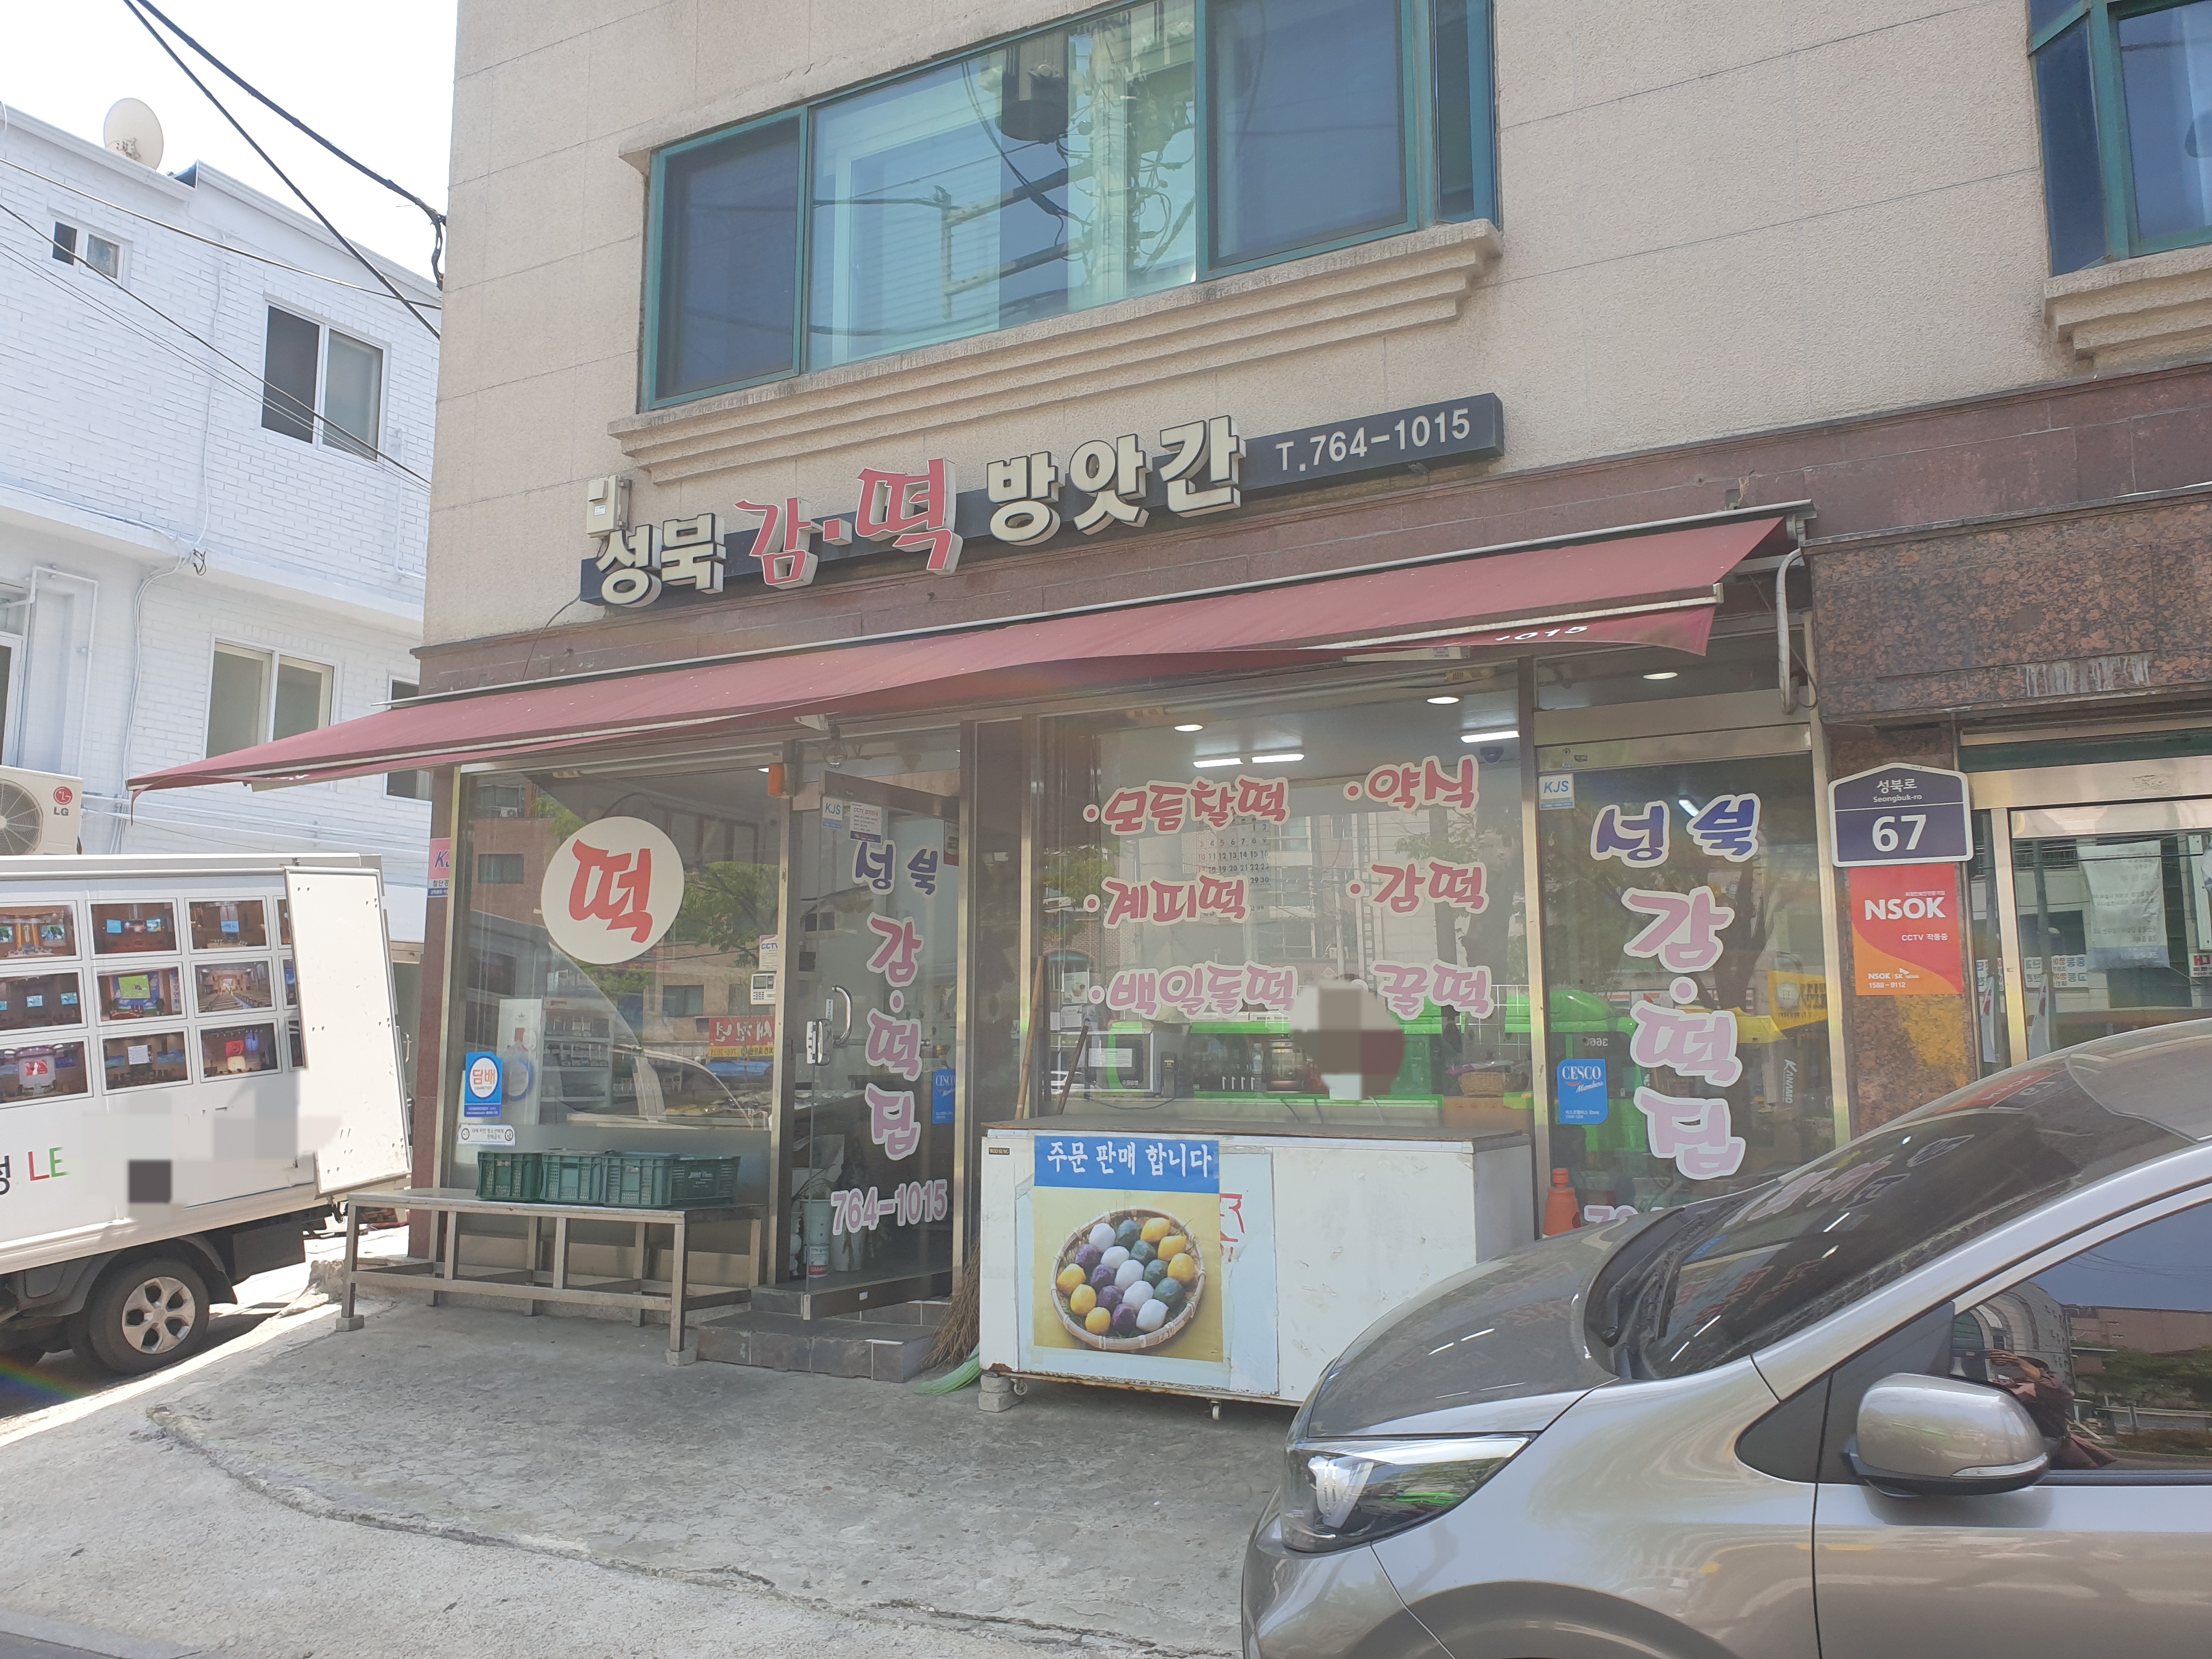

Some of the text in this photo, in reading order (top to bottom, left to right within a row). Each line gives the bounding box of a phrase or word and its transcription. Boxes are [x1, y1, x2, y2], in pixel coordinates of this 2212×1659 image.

[596, 513, 721, 606] 성북
[987, 415, 1243, 543] 방앗간
[1275, 408, 1471, 472] T.764-1015
[1543, 781, 1570, 793] KJS
[1877, 778, 1917, 794] 성북로
[1872, 794, 1923, 803] Seongbuk-ro
[53, 807, 69, 816] LG
[825, 803, 841, 815] KJS
[1872, 814, 1927, 852] 67
[568, 838, 653, 944] 떡
[1865, 896, 1946, 921] NSOK
[472, 1069, 495, 1085] 담배
[1562, 1066, 1601, 1080] CESCO
[1576, 1080, 1604, 1093] Members
[1047, 1141, 1213, 1178] 주문 판매 합니다
[831, 1180, 947, 1235] 764-1015
